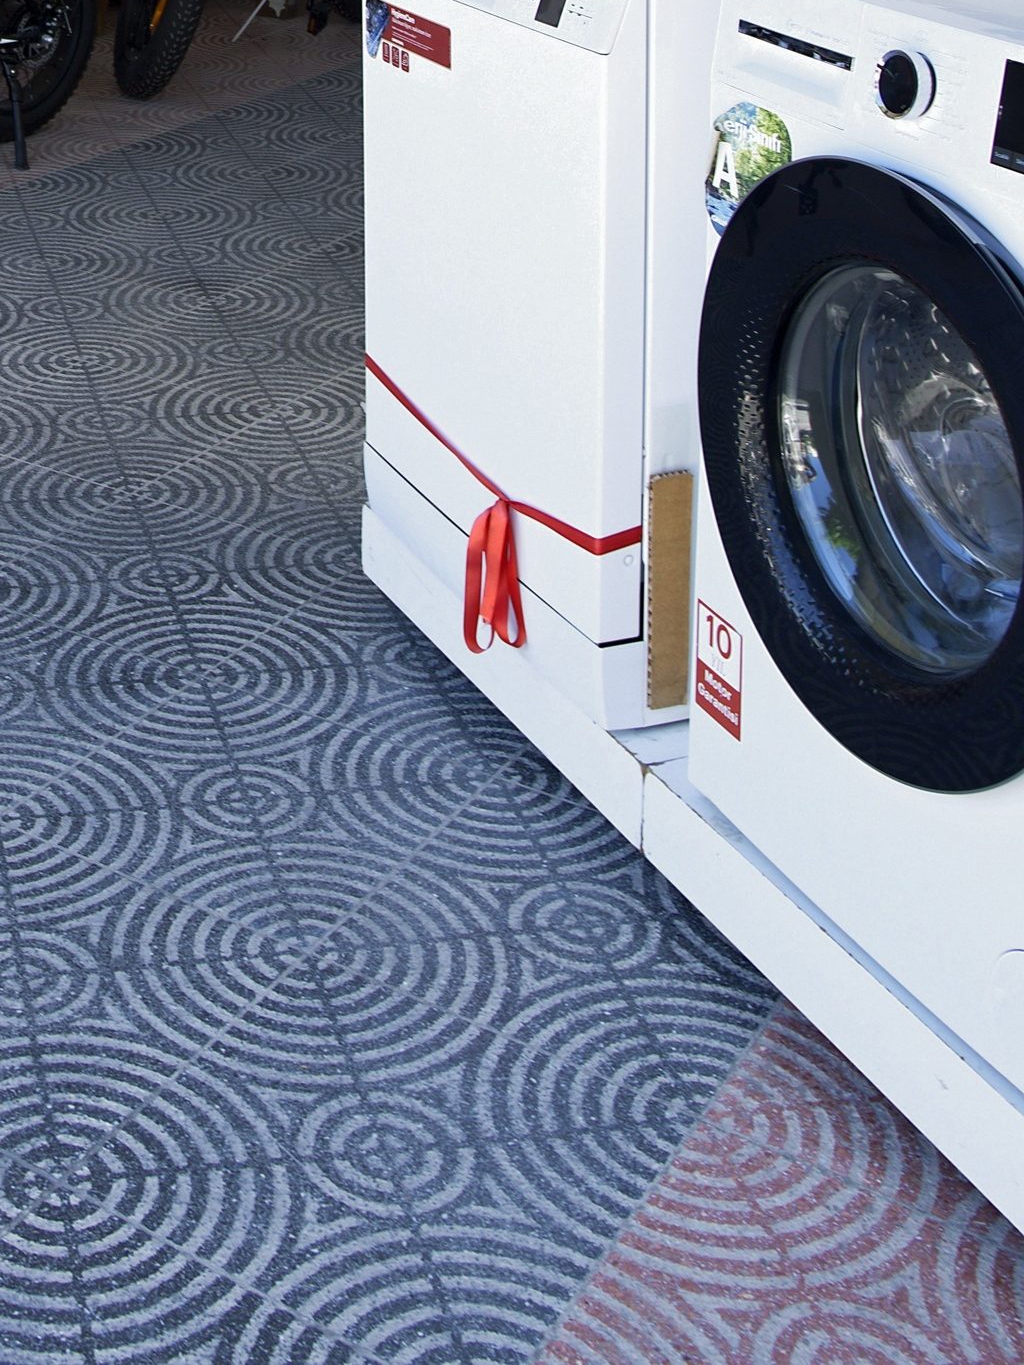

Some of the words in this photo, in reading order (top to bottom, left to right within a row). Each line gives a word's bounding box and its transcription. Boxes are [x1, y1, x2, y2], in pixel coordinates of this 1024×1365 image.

[712, 141, 739, 198] A
[706, 614, 732, 660] 10
[697, 682, 739, 726] Garantisi
[704, 669, 733, 700] Motor
